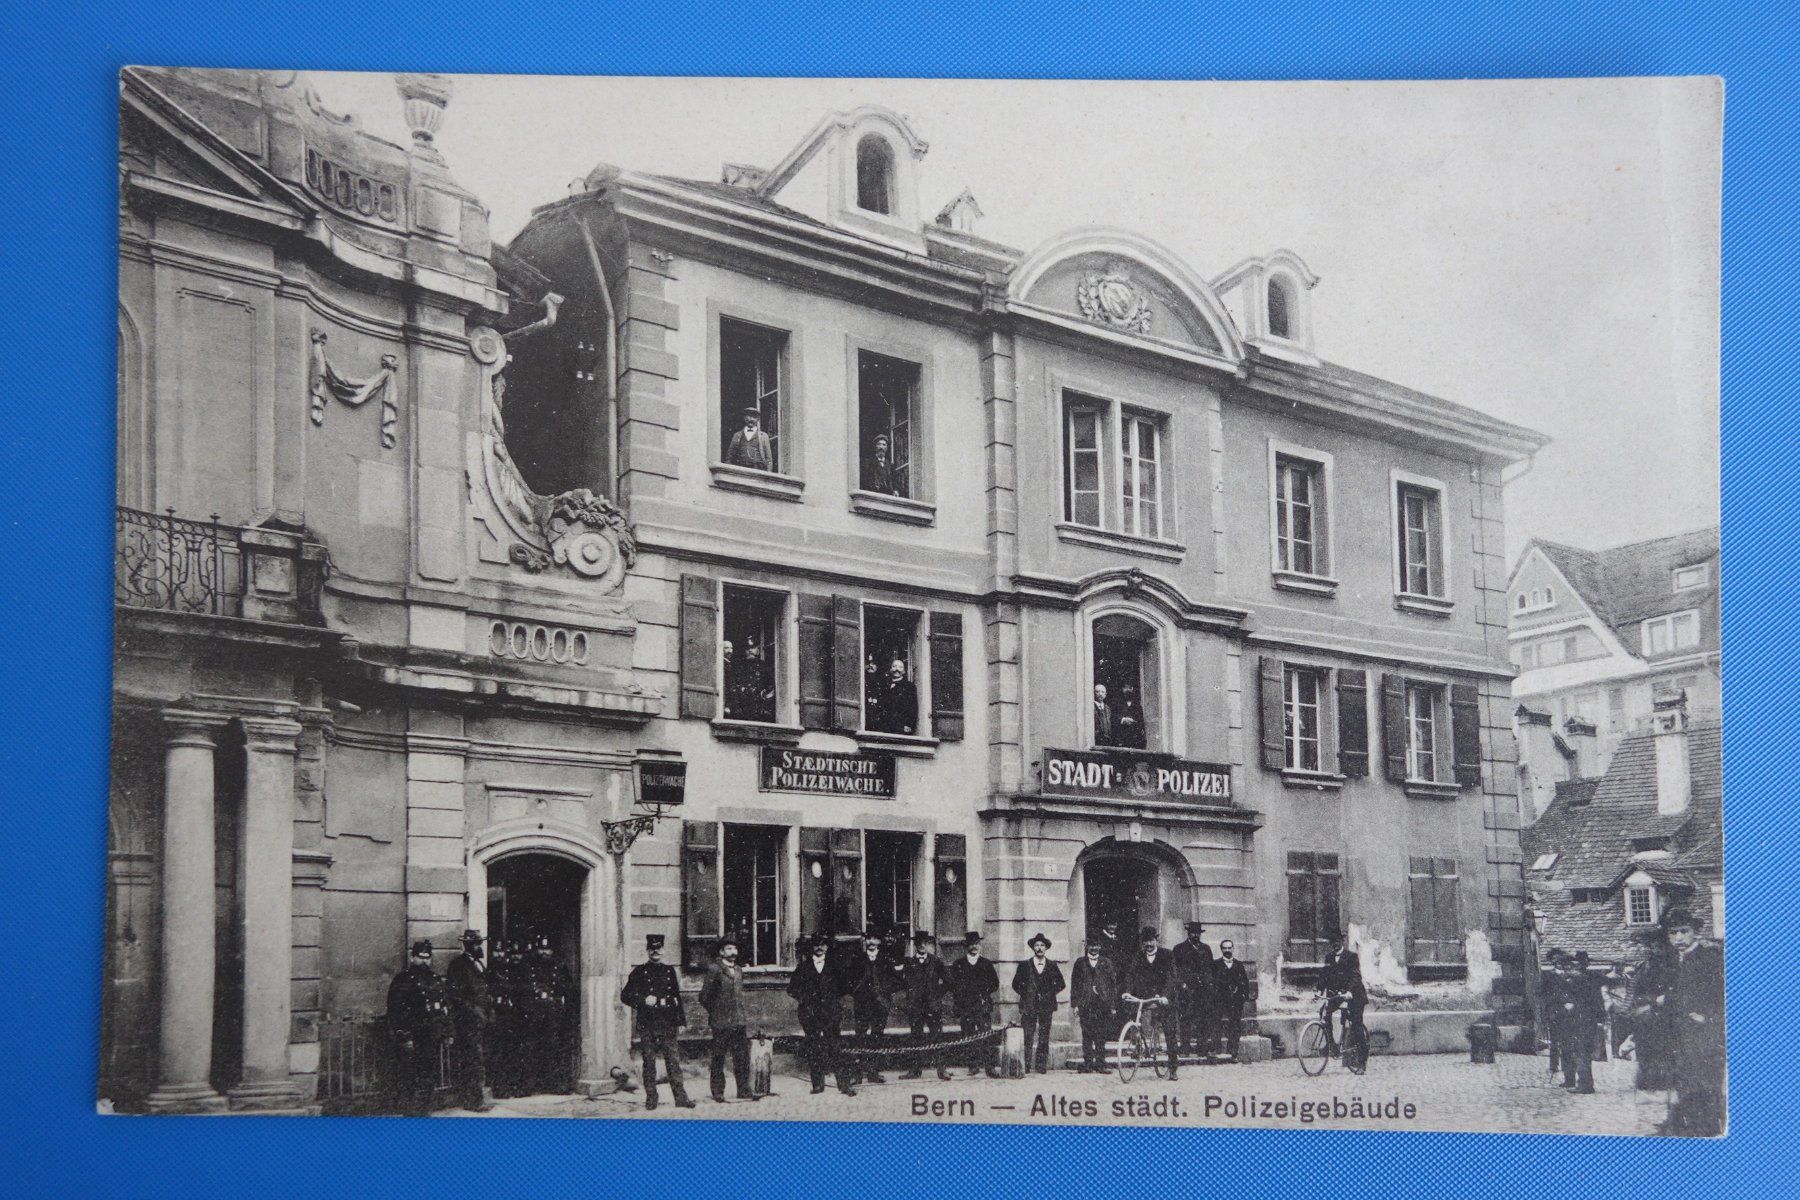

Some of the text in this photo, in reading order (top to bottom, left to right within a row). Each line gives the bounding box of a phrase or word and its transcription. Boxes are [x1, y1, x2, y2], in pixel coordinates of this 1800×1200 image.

[1157, 768, 1230, 798] POLIZEI
[911, 1094, 976, 1117] Bern
[1030, 1094, 1098, 1118] Altes
[1111, 1094, 1188, 1119] städt.
[1204, 1096, 1417, 1123] Polizeigebäude
